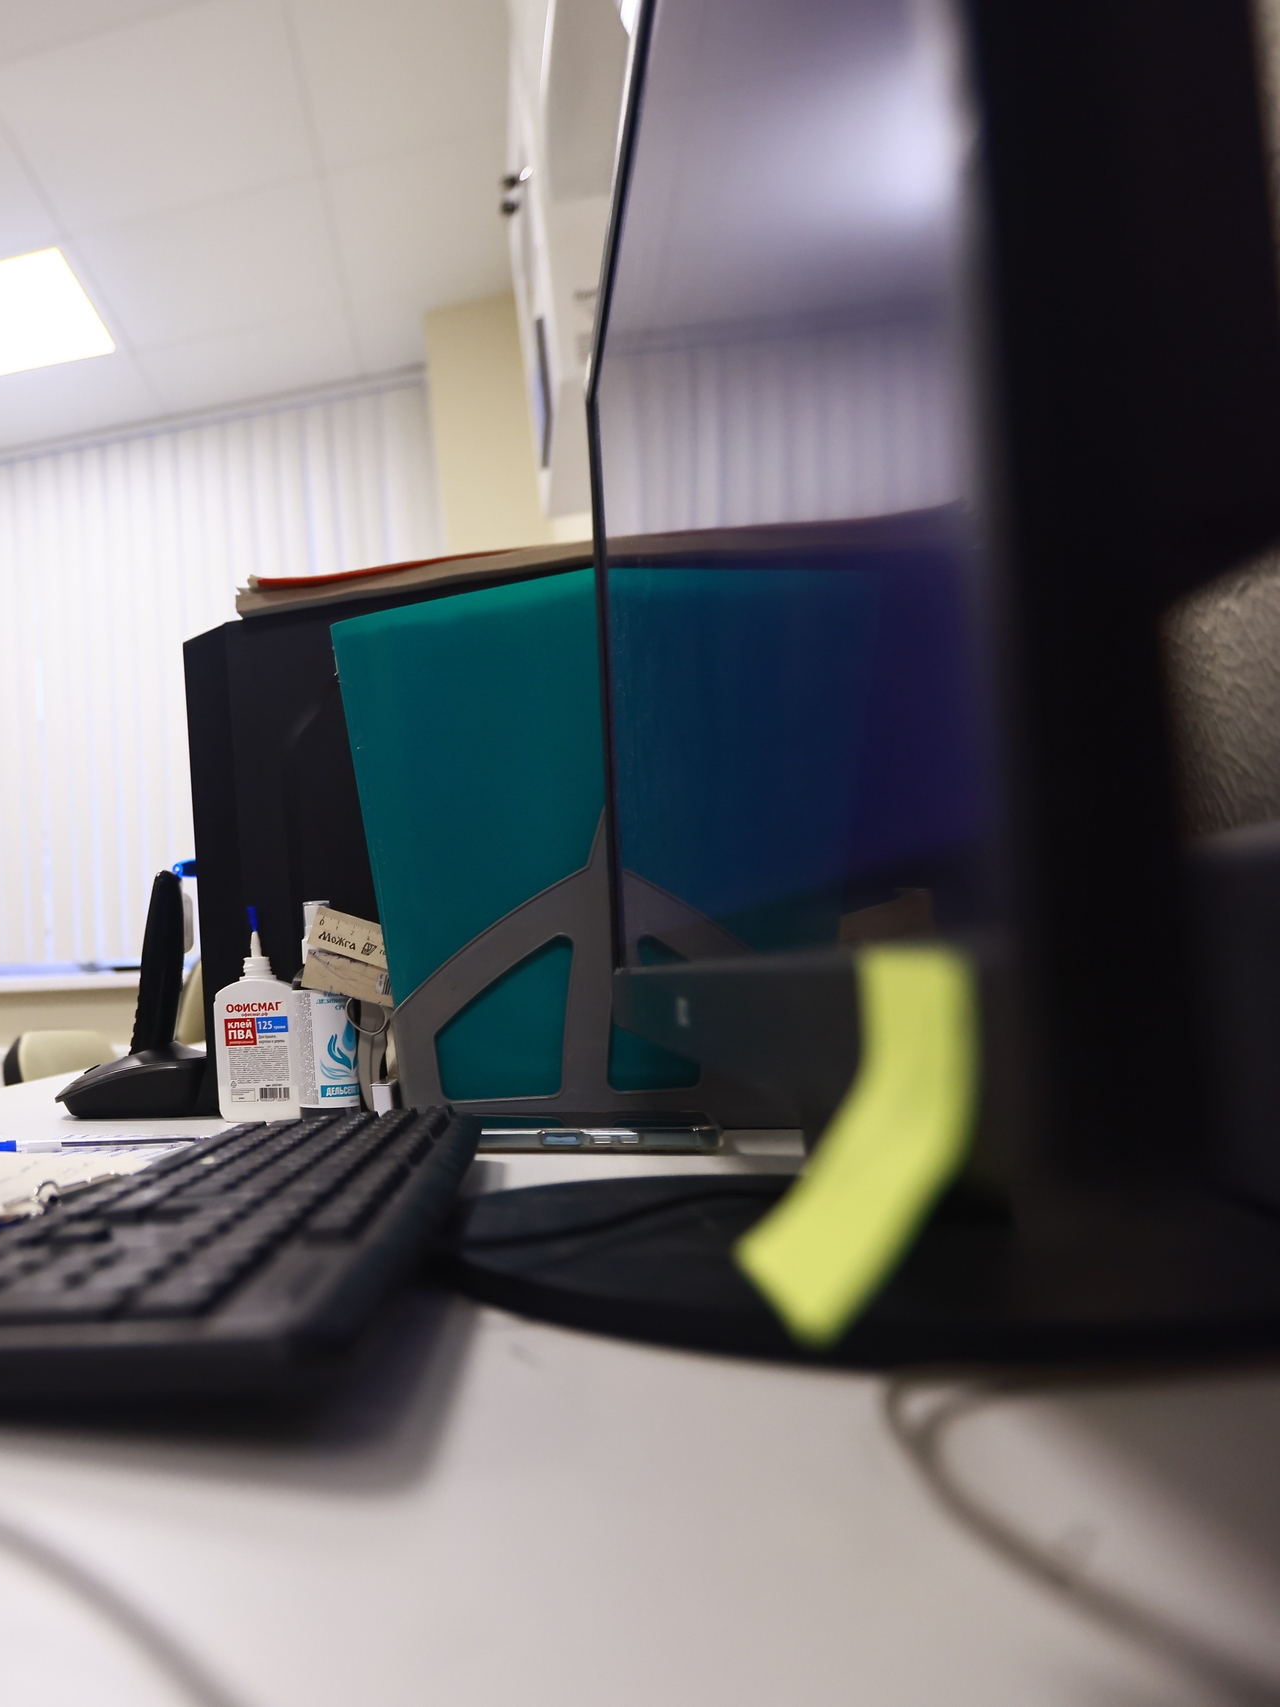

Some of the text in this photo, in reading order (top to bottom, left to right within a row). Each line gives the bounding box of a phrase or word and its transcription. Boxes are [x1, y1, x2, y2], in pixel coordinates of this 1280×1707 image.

[318, 931, 356, 950] Можга
[226, 1002, 282, 1013] ОФИСМАГ
[228, 1019, 252, 1028] клей
[258, 1020, 272, 1030] 125
[228, 1029, 253, 1040] ПВА
